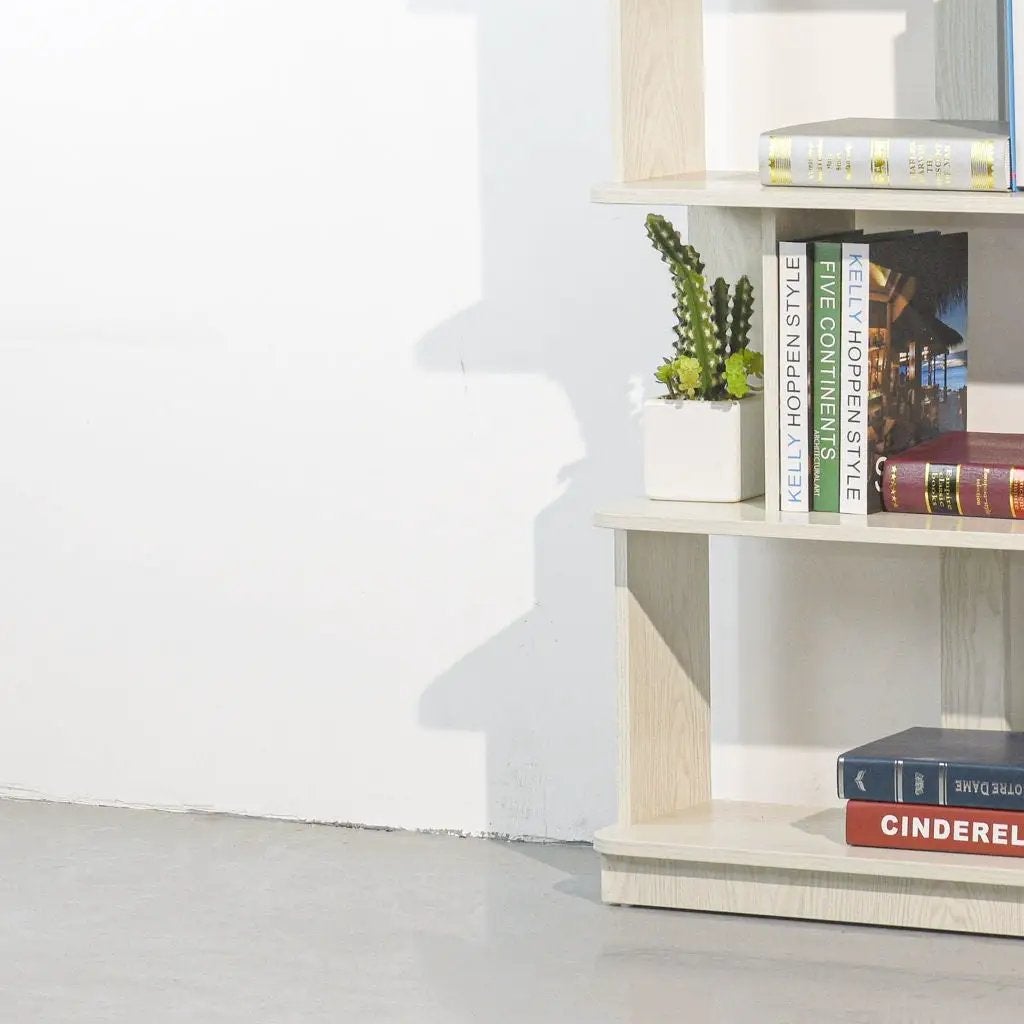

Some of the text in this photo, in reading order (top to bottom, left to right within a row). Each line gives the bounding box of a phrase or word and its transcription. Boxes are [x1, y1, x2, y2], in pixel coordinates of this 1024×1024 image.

[786, 257, 802, 503] KELLY HOPPEN STYLE
[820, 261, 836, 460] FIVE CONTINENTS
[846, 254, 863, 501] KELLY HOPPEN STYLE
[944, 469, 953, 510] Empire
[955, 779, 990, 796] DAME
